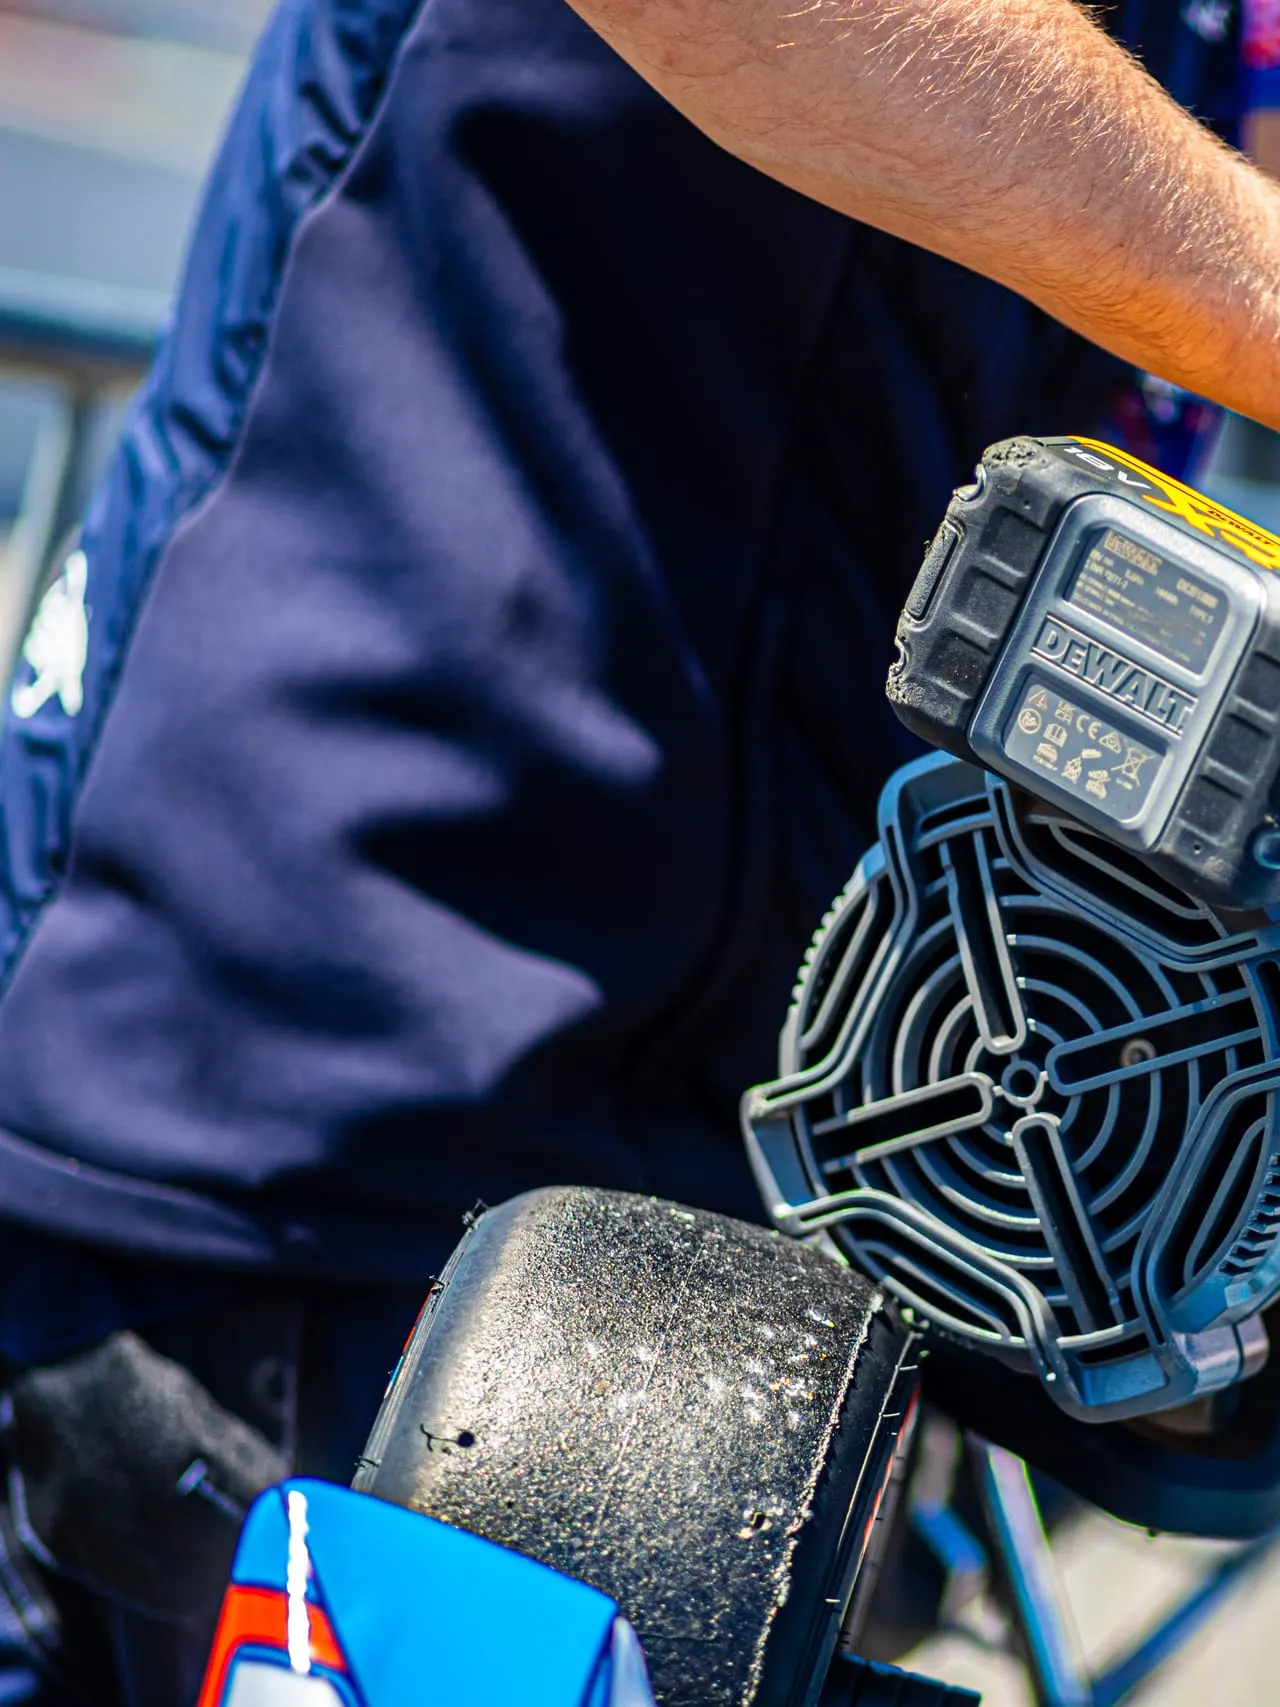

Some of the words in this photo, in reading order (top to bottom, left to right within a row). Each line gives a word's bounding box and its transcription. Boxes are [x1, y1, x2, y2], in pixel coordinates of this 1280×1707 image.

[1064, 446, 1152, 489] 18V
[1031, 614, 1196, 738] DEWALT
[1076, 714, 1102, 740] CE
